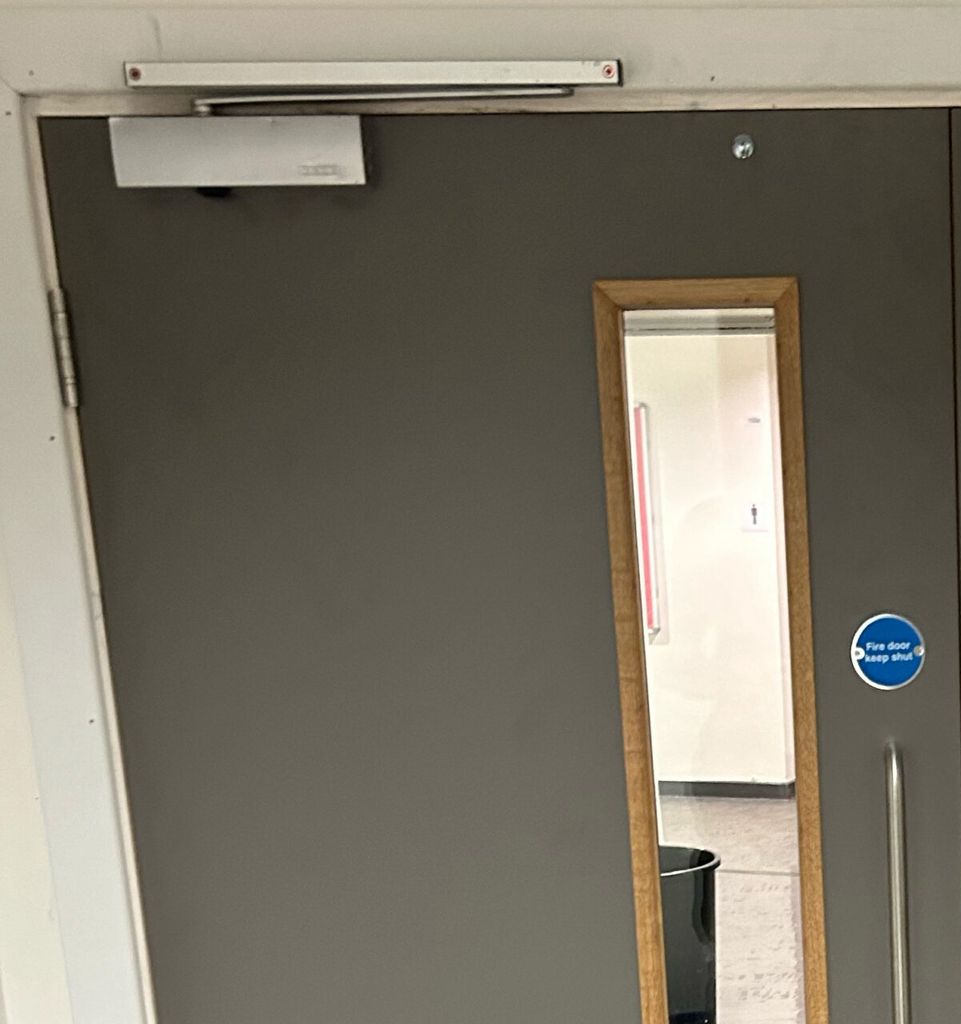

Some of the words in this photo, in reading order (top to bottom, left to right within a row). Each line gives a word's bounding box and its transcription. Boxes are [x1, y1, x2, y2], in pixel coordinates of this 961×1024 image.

[865, 642, 885, 651] Fire
[887, 641, 911, 650] door
[865, 653, 889, 664] keep
[891, 652, 913, 661] shut
